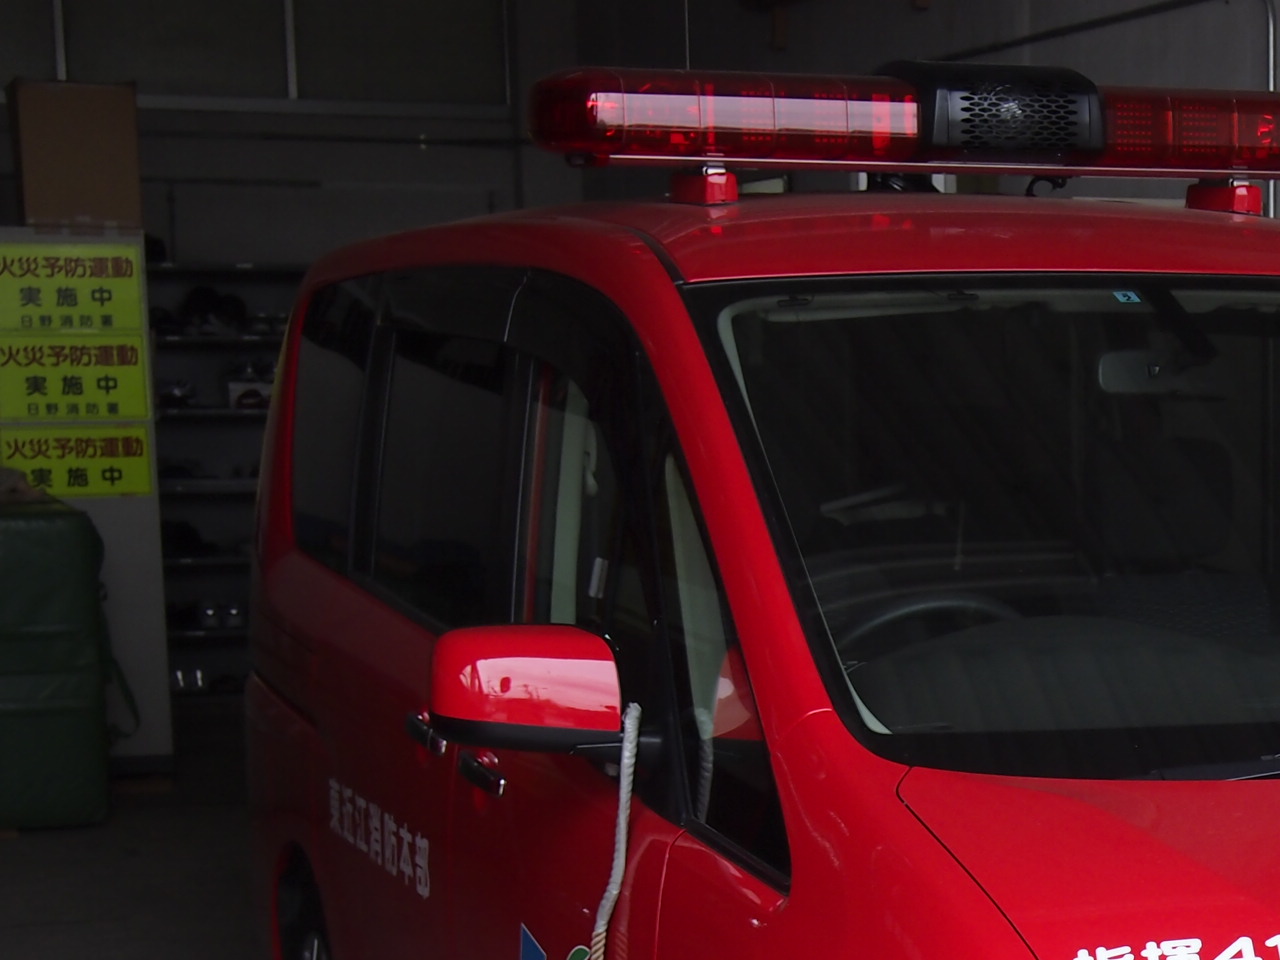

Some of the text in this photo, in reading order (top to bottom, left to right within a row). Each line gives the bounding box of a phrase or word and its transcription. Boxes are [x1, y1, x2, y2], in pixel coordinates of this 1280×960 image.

[0, 256, 134, 278] 火災予防運動
[0, 344, 139, 367] 火災予防運動
[6, 436, 144, 459] 火災予防運動
